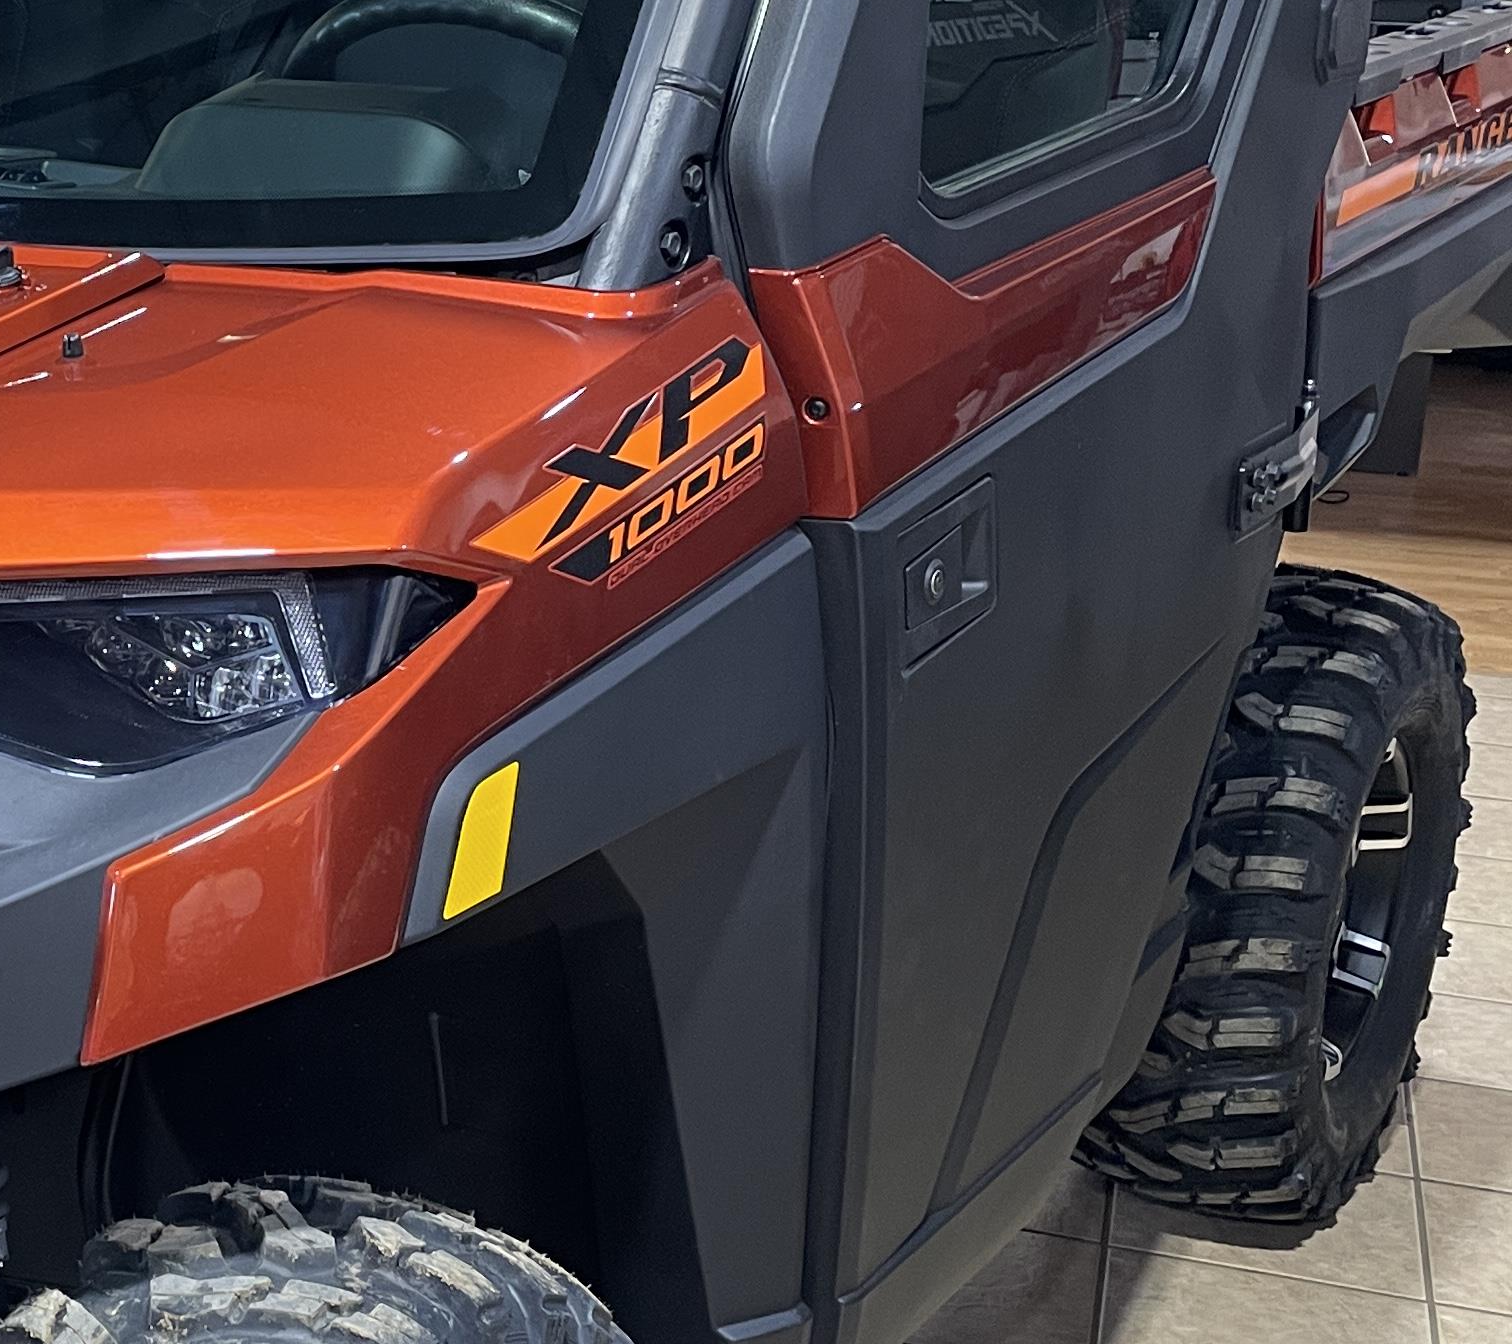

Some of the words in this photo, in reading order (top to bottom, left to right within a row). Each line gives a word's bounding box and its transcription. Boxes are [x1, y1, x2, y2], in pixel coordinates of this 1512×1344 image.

[1414, 108, 1512, 192] RANG
[534, 336, 751, 553] XP
[608, 422, 764, 565] 1000
